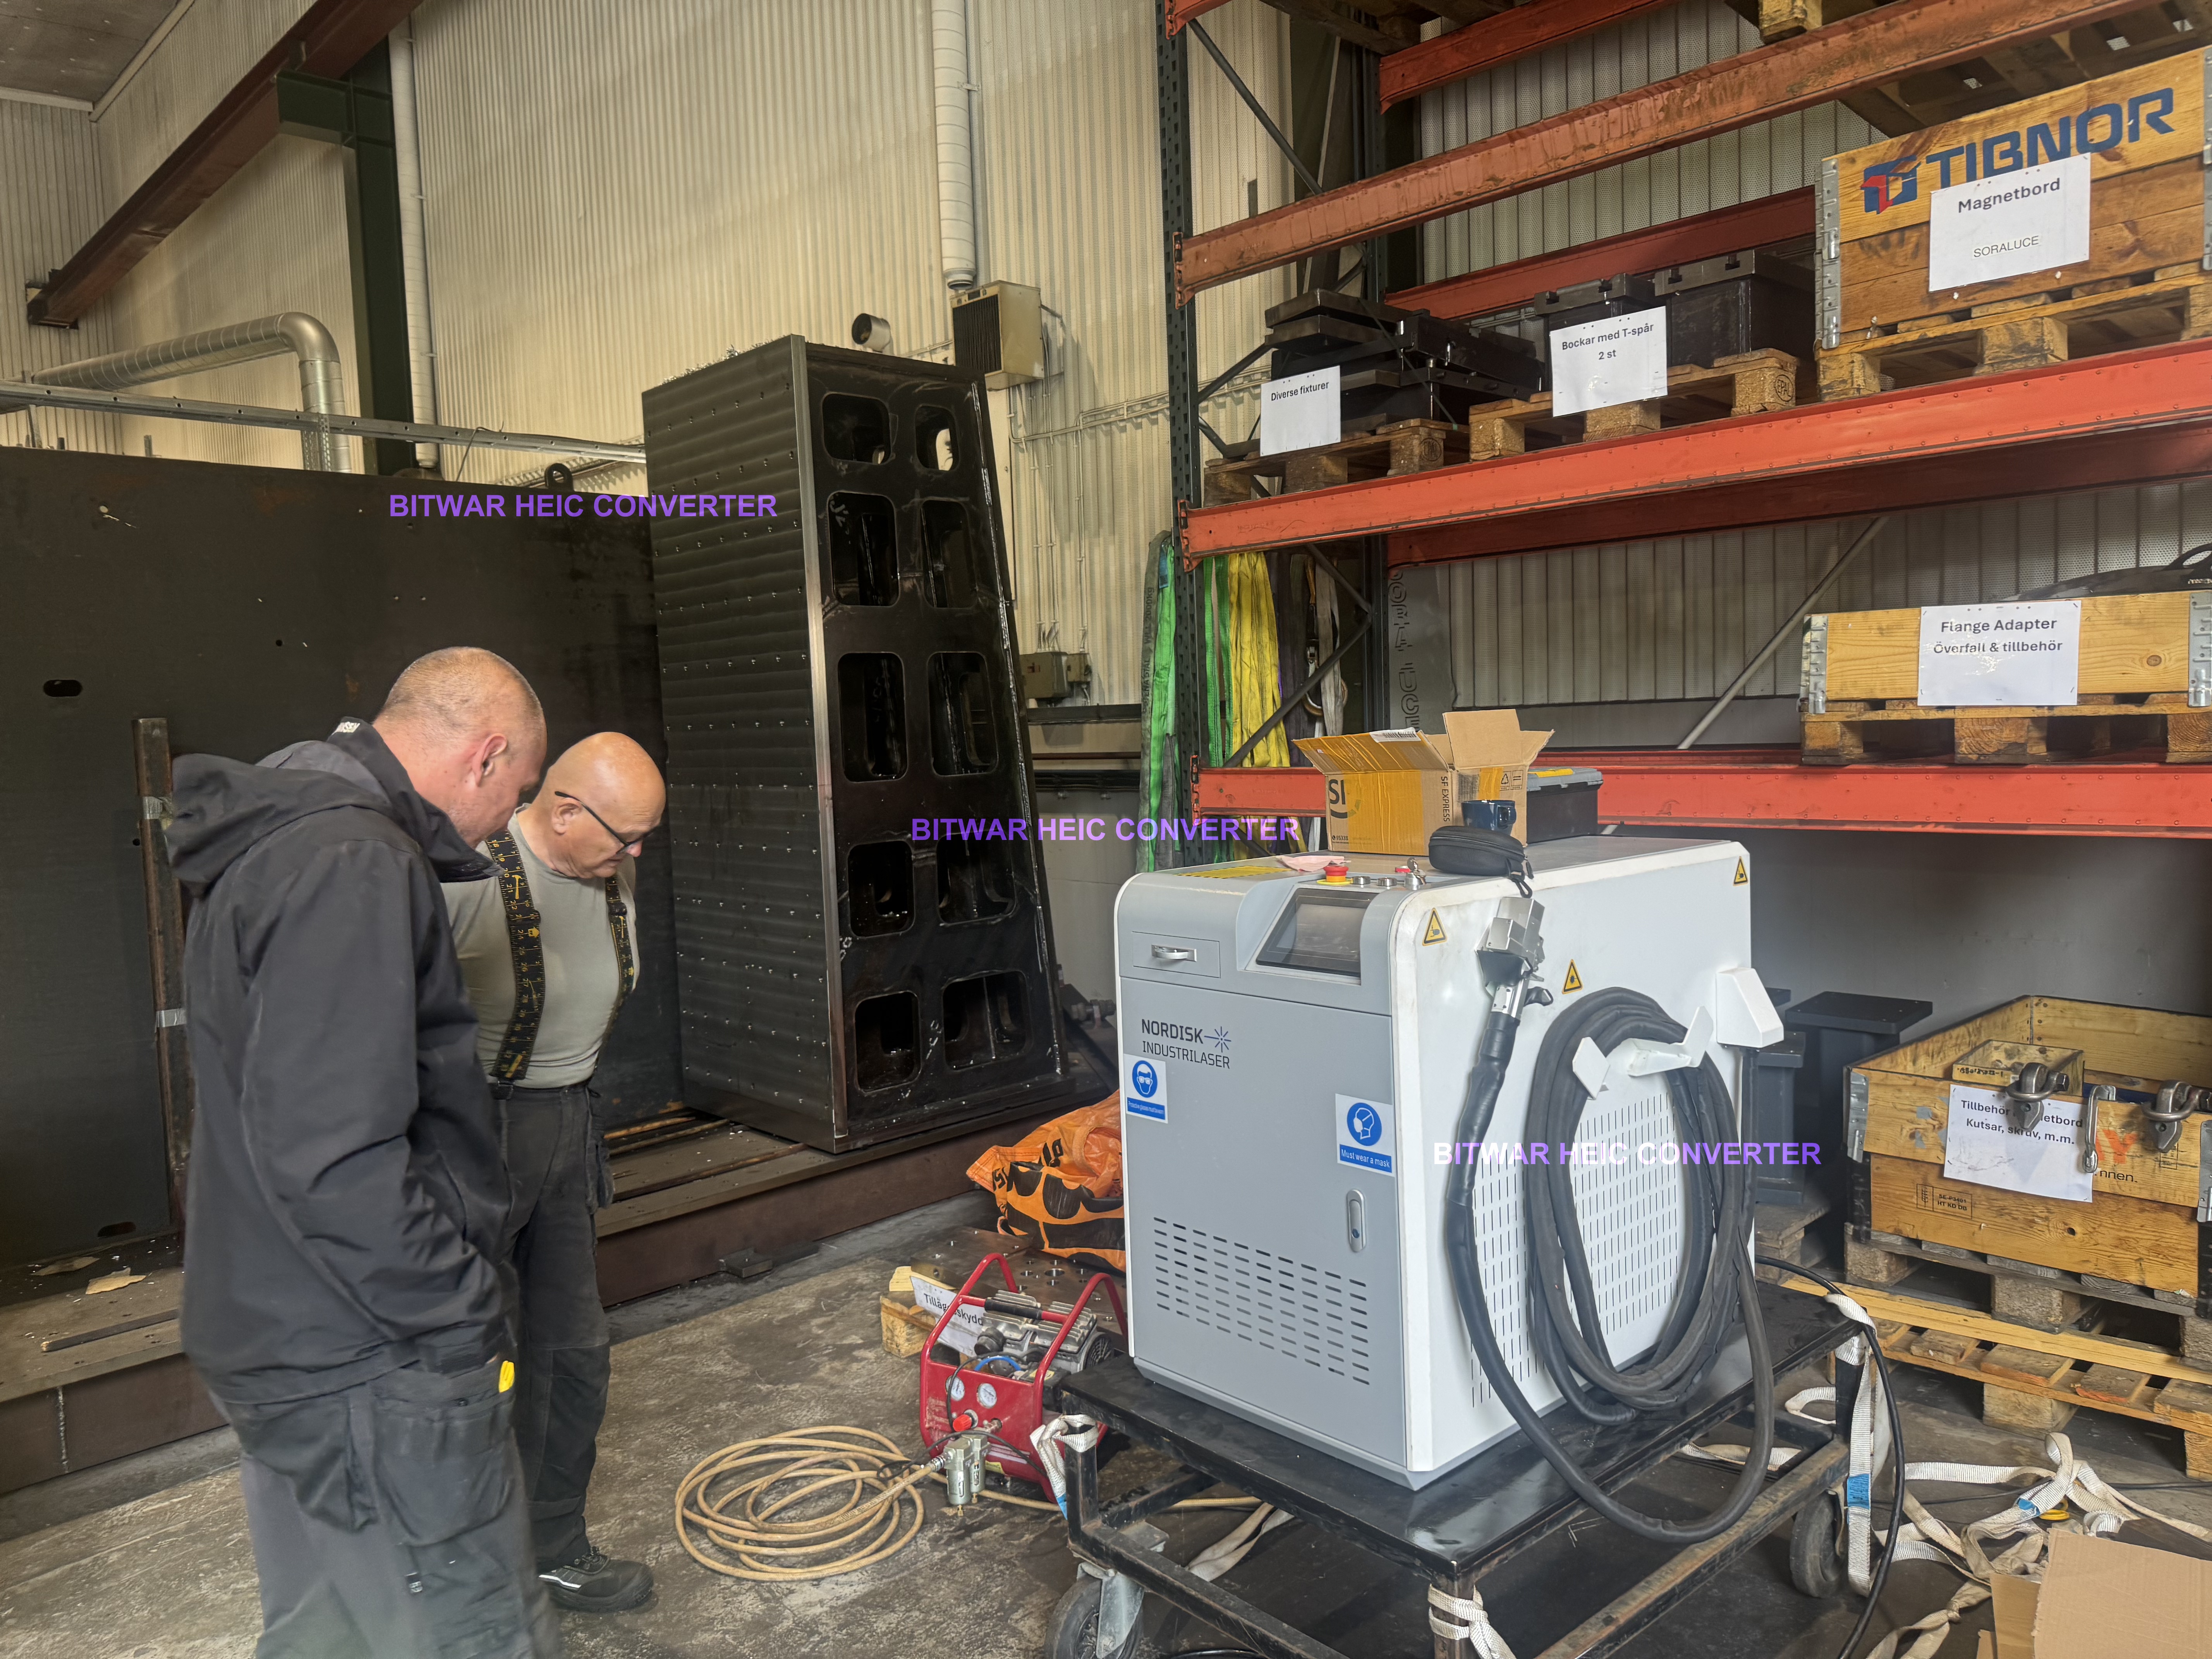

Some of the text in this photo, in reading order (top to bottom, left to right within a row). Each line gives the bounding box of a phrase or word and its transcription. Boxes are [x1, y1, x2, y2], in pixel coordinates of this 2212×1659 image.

[1926, 88, 2176, 189] TIBNOR
[1958, 178, 2060, 213] Magnetbord
[1973, 235, 2039, 258] SORALUCE
[1562, 323, 1654, 350] Bockar med T-spår
[1599, 350, 1616, 360] 2 st
[1271, 382, 1329, 401] Diverse fixturer
[1941, 619, 2057, 634] Flange Adapter
[1934, 640, 2063, 654] Överfall & tillbehör
[1441, 776, 1450, 822] SF EXPRESS
[1142, 1018, 1204, 1044] NORDISK
[1142, 1041, 1230, 1069] INDUSTRILASER
[1961, 1100, 2010, 1116] Tillbehör
[1966, 1118, 2075, 1144] Kutsar, skruv, m.m.
[1341, 1149, 1355, 1159] Must
[1355, 1154, 1369, 1163] wear
[1375, 1159, 1390, 1168] mask
